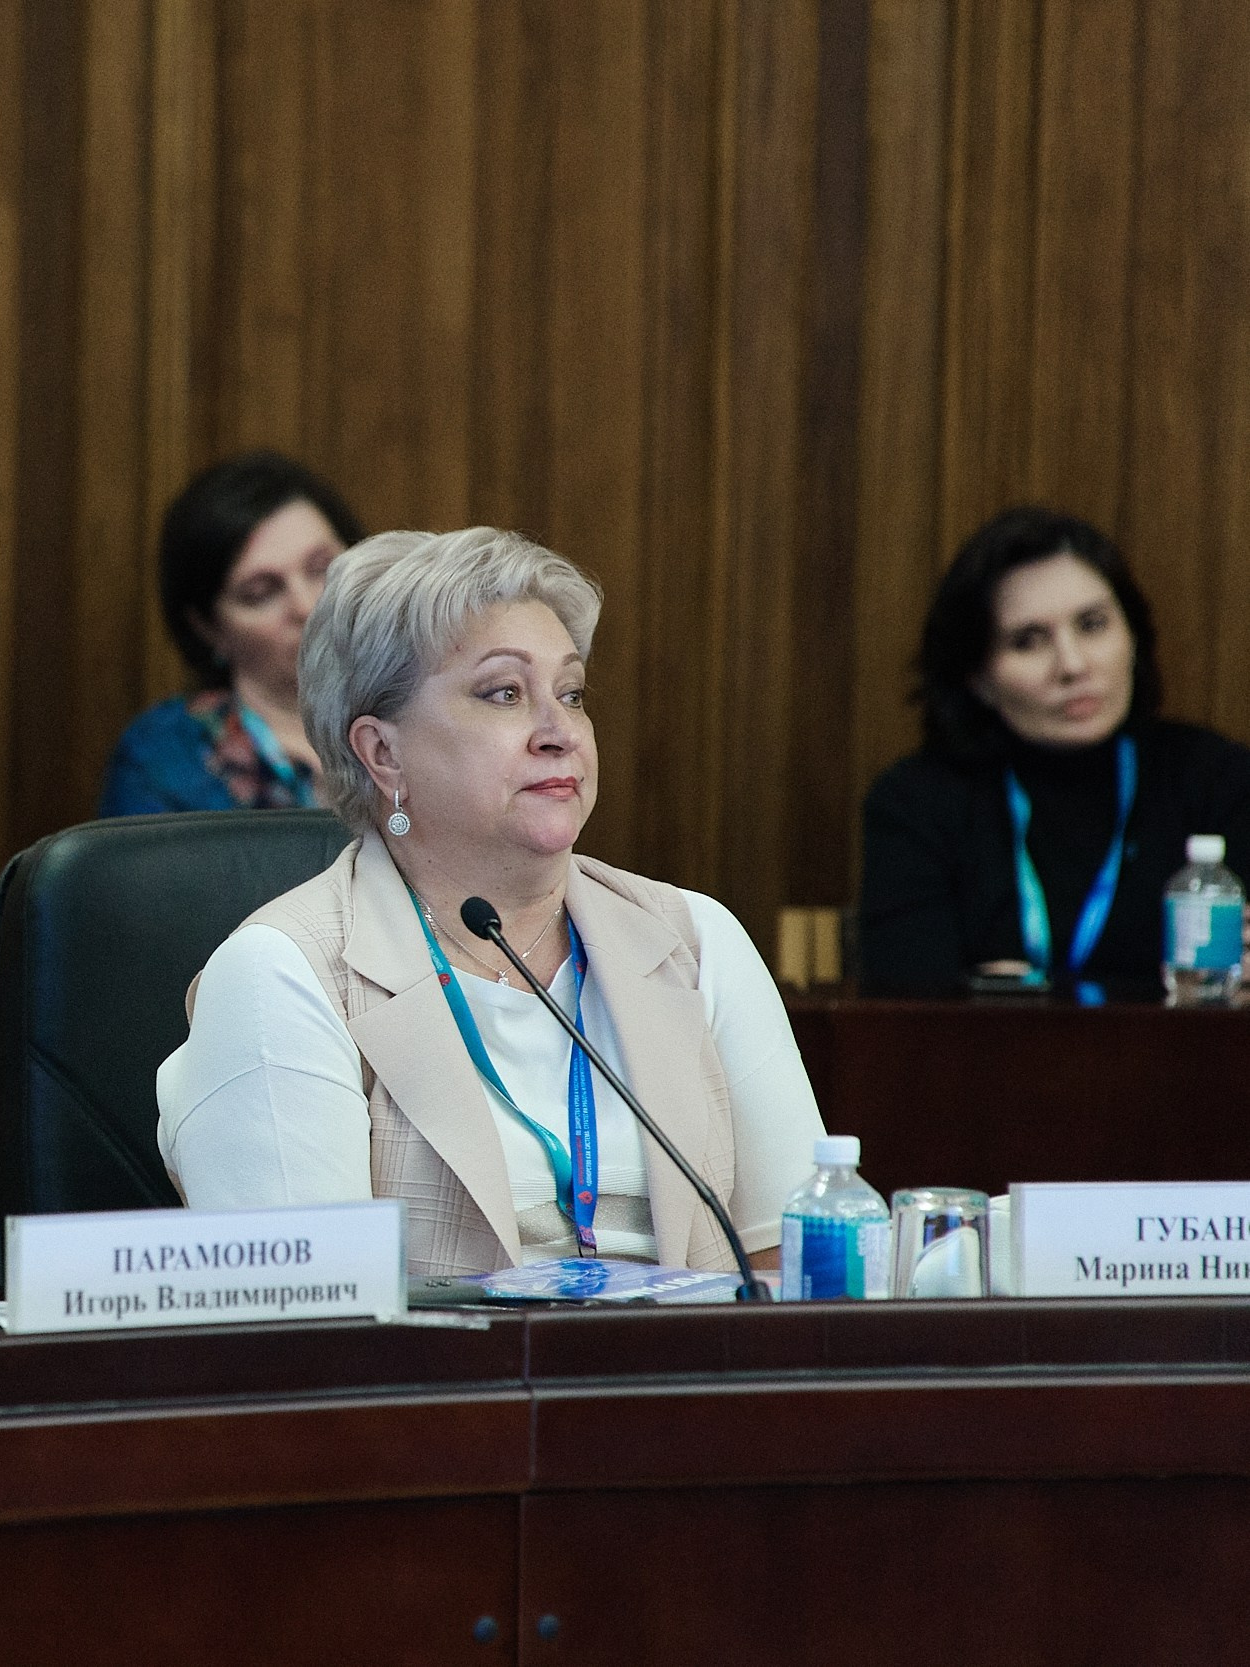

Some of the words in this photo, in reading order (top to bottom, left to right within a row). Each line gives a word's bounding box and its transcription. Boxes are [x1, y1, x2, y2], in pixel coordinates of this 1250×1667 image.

[1137, 1216, 1250, 1241] ГУБАН
[113, 1238, 312, 1274] ПАРАМОНОВ
[1076, 1255, 1190, 1288] Марина
[64, 1289, 147, 1321] Игорь
[157, 1282, 358, 1312] Владимирович
